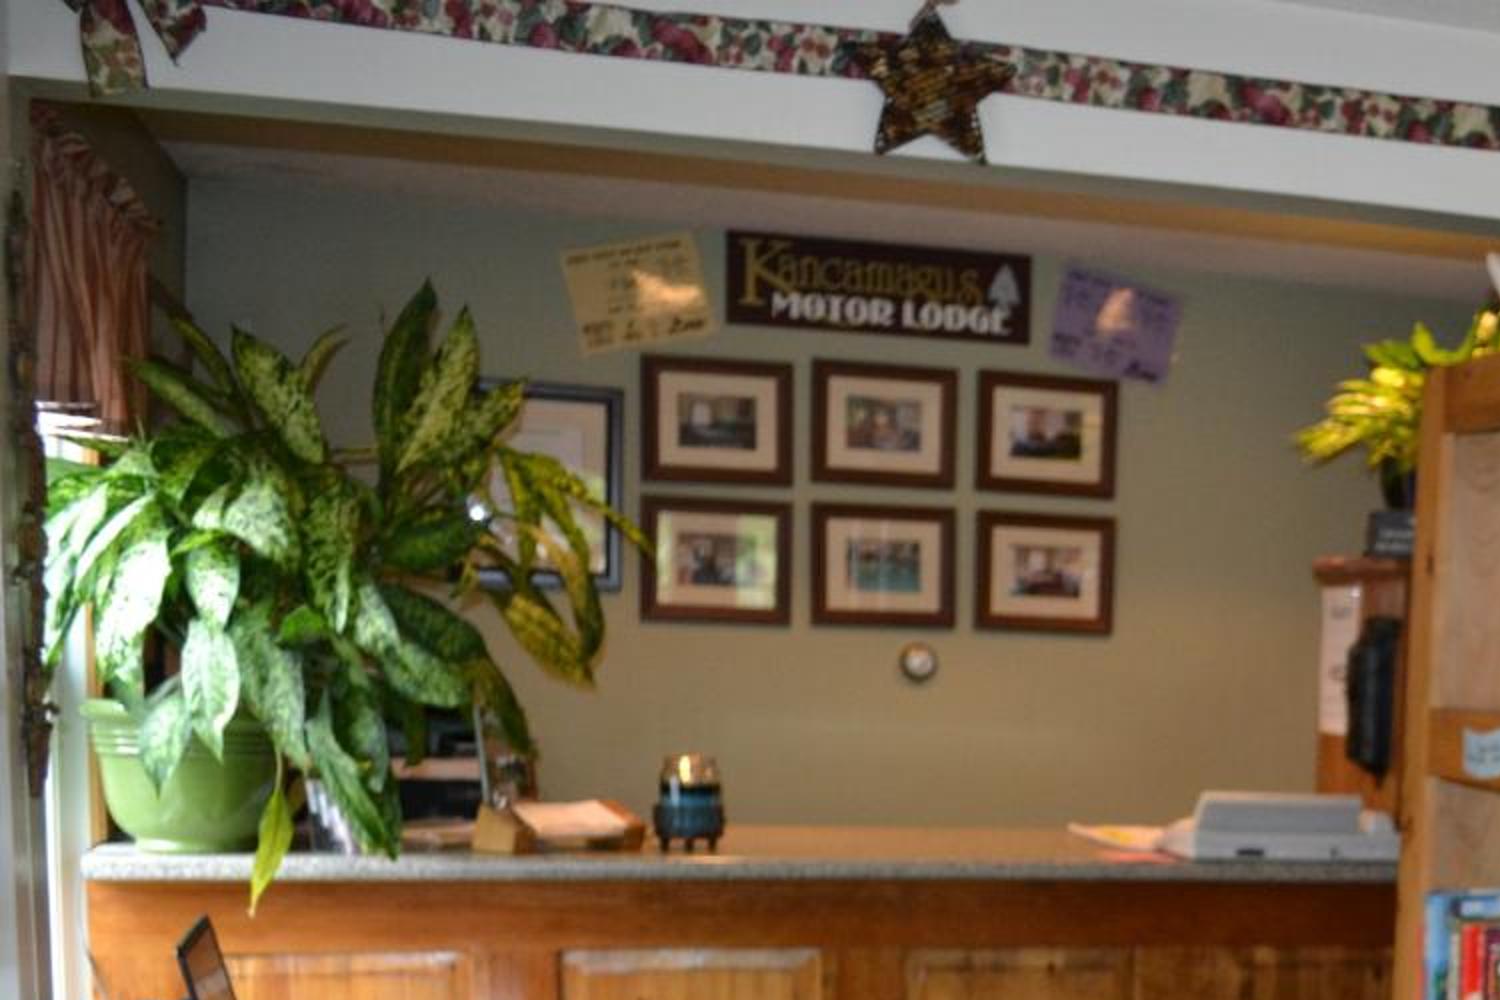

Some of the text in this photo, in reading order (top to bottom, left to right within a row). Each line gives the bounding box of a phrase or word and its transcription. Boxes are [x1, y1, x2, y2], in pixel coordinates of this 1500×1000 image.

[739, 238, 984, 307] Kancamagus
[771, 290, 1012, 337] MOTOR LODGE
